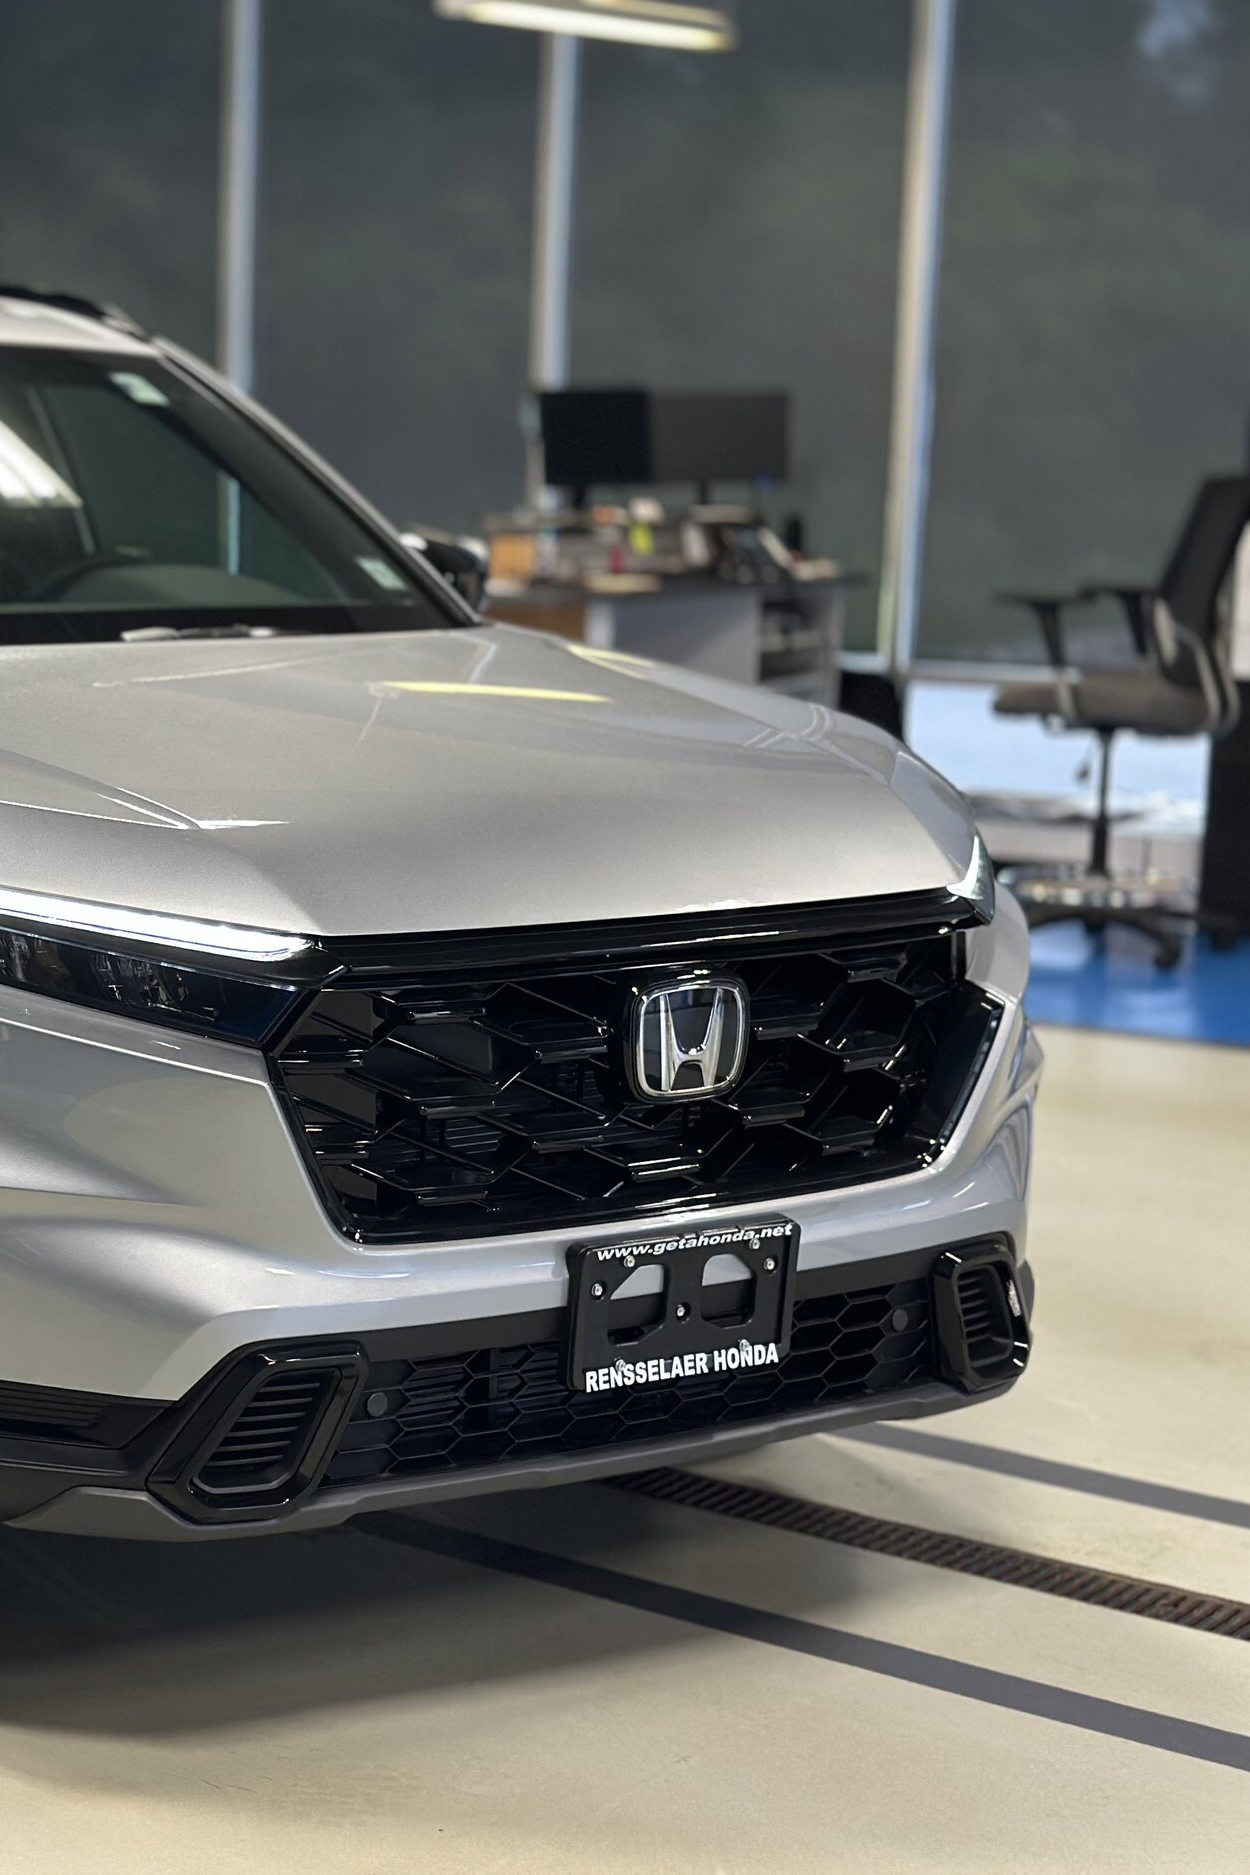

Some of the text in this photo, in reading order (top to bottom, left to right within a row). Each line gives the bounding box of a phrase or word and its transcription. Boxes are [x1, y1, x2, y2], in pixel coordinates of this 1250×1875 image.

[597, 1224, 793, 1261] www.getahonda.net
[585, 1343, 779, 1393] RENSSELAER HONDA
